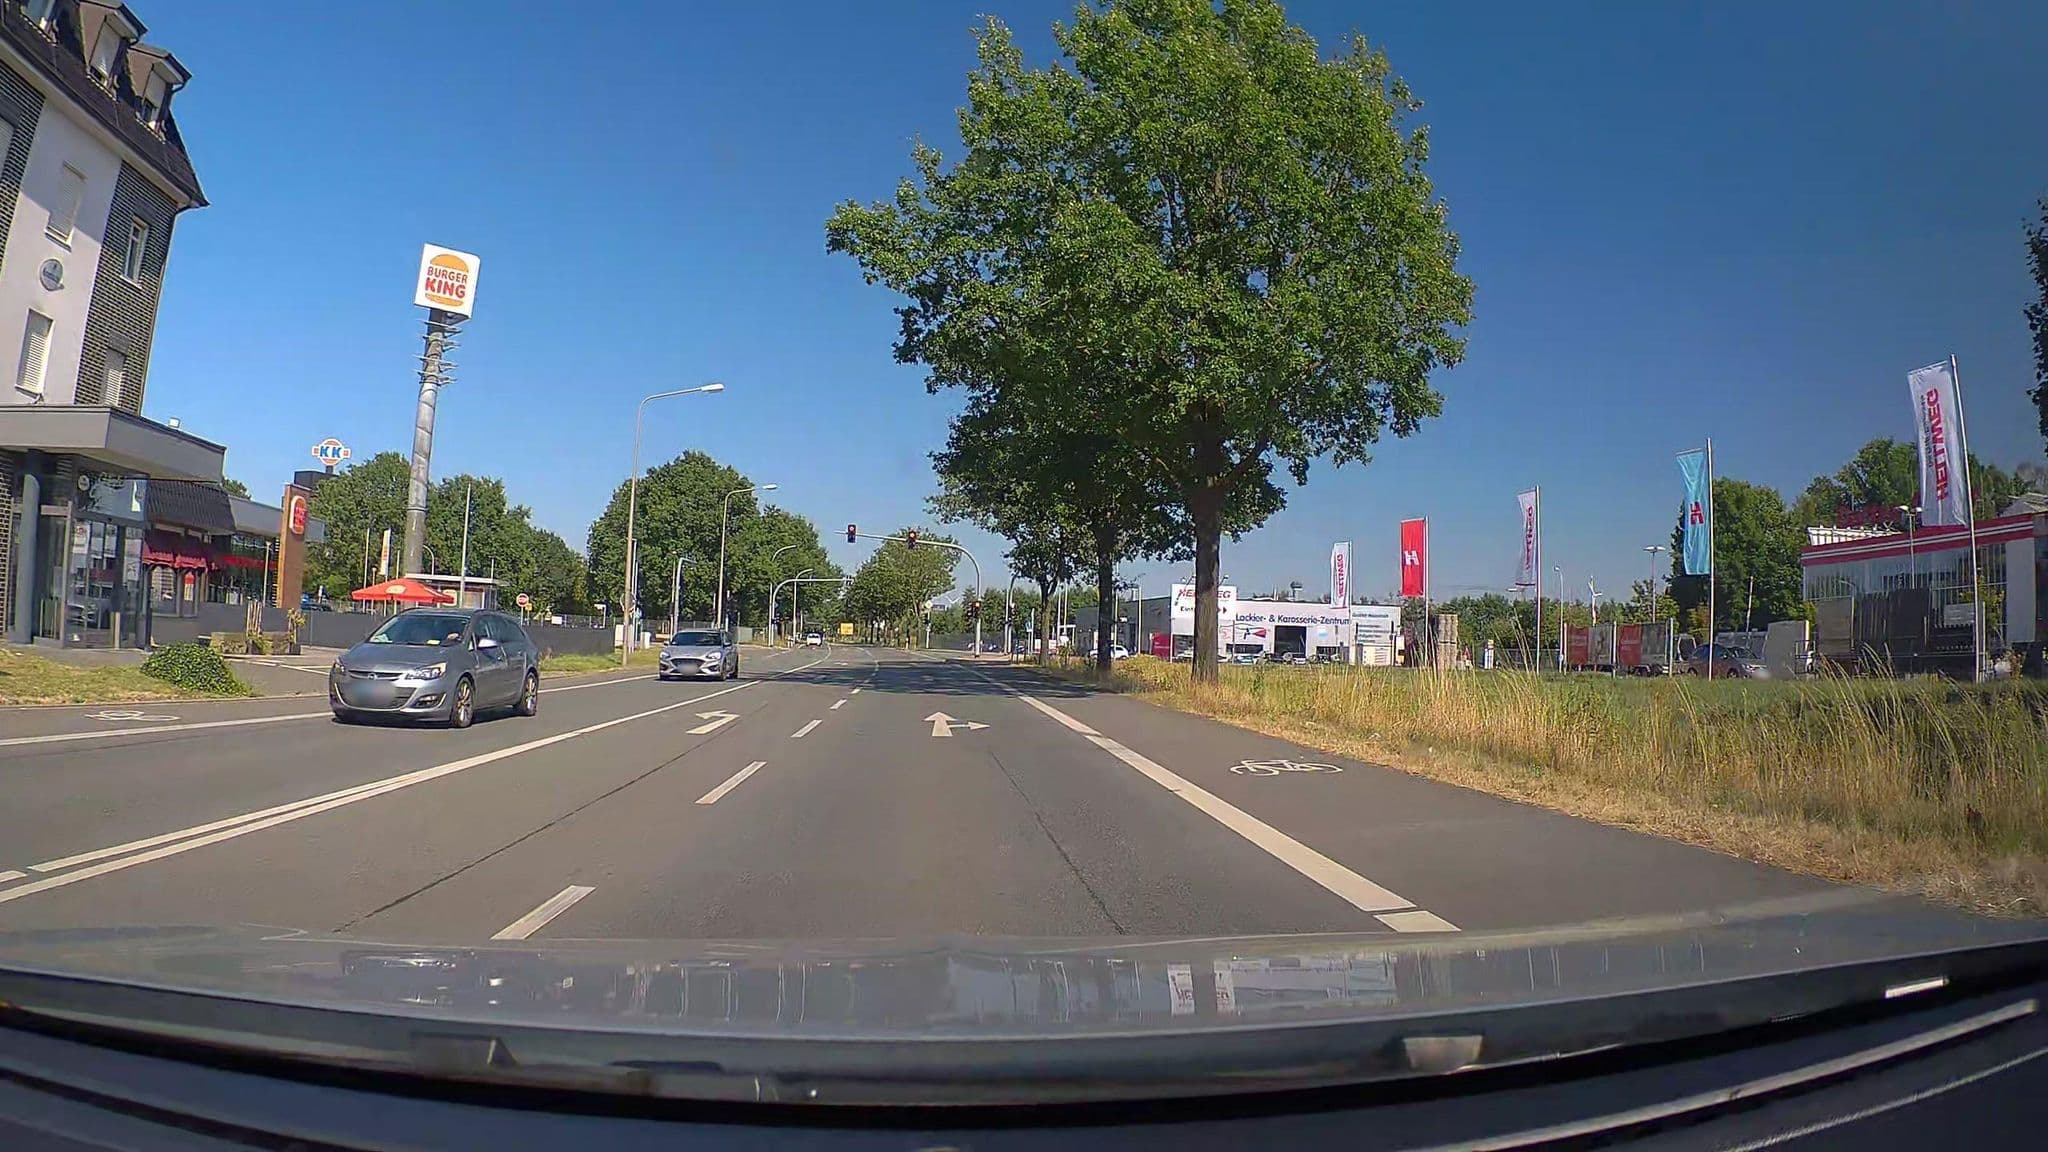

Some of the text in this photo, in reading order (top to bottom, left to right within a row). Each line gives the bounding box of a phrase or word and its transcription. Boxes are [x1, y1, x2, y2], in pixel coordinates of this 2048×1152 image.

[427, 266, 468, 284] BURGER
[425, 277, 466, 298] KING
[1926, 388, 1949, 501] HELLWEG
[1404, 550, 1420, 566] H
[1268, 614, 1275, 623] &
